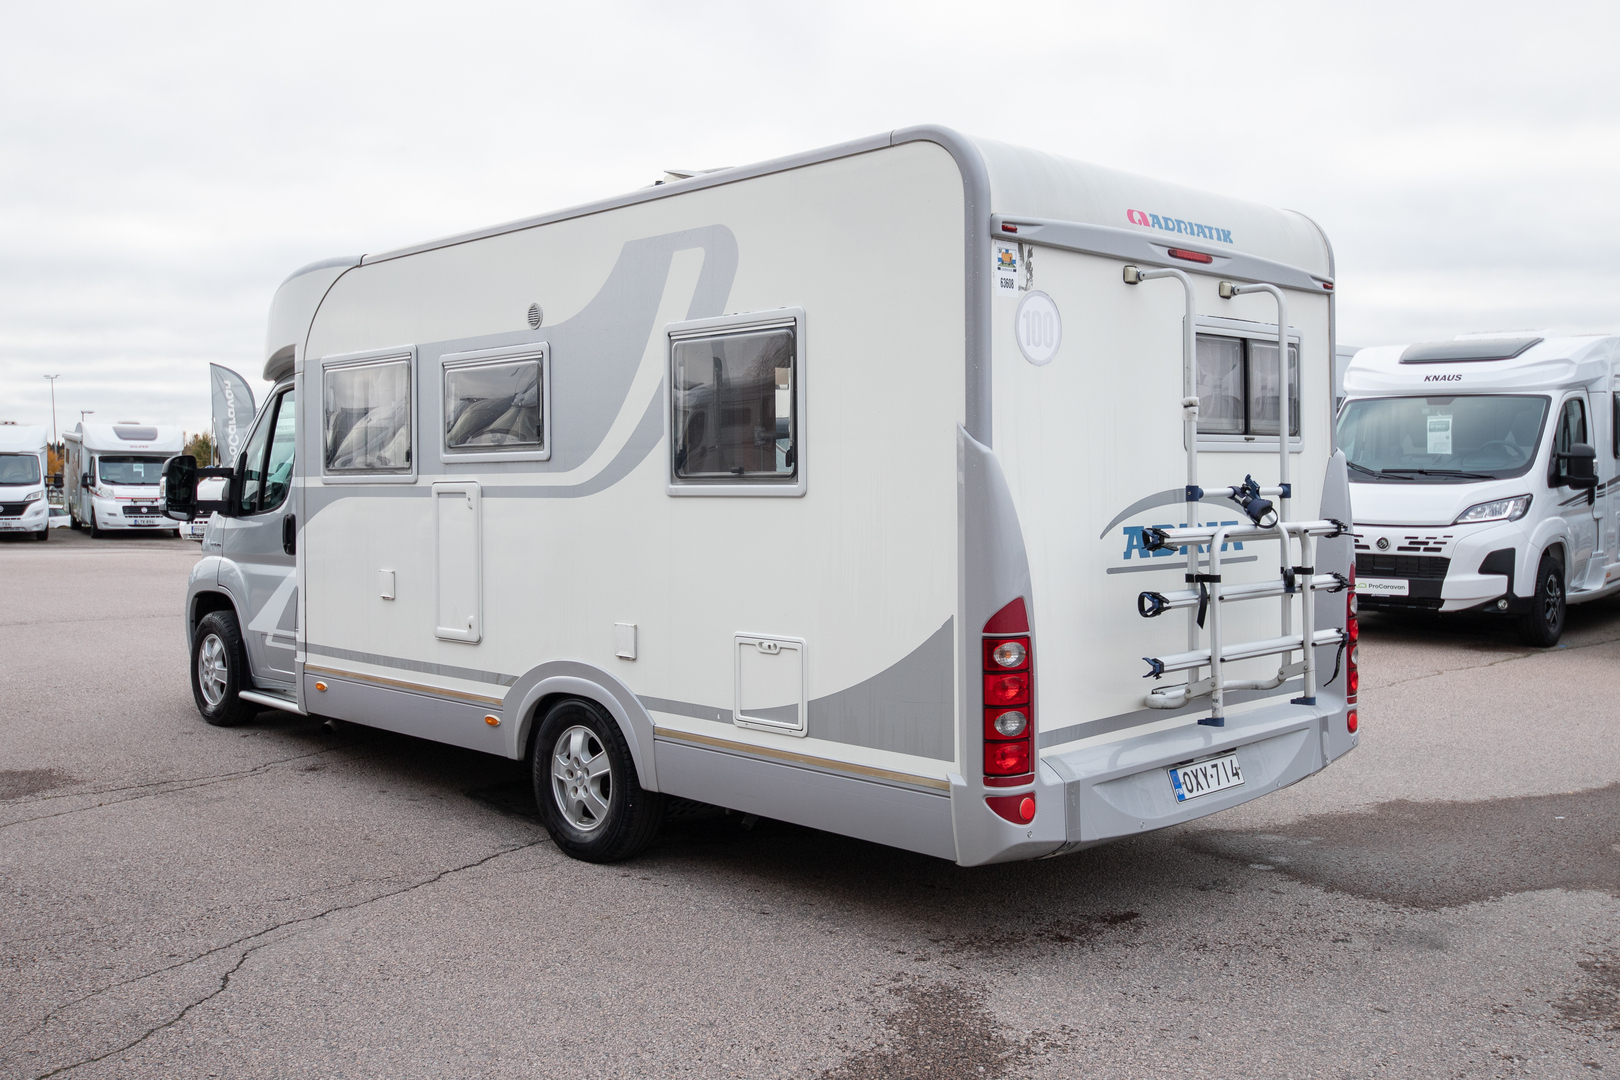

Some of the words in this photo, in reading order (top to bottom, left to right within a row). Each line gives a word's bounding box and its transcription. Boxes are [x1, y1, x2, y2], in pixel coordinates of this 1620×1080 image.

[1149, 213, 1234, 245] ADRIATIK
[1000, 277, 1014, 289] 63608
[1023, 309, 1053, 348] 100
[1424, 374, 1463, 382] KNAUS
[223, 380, 240, 463] oCaravan
[1182, 759, 1241, 794] OXY-714
